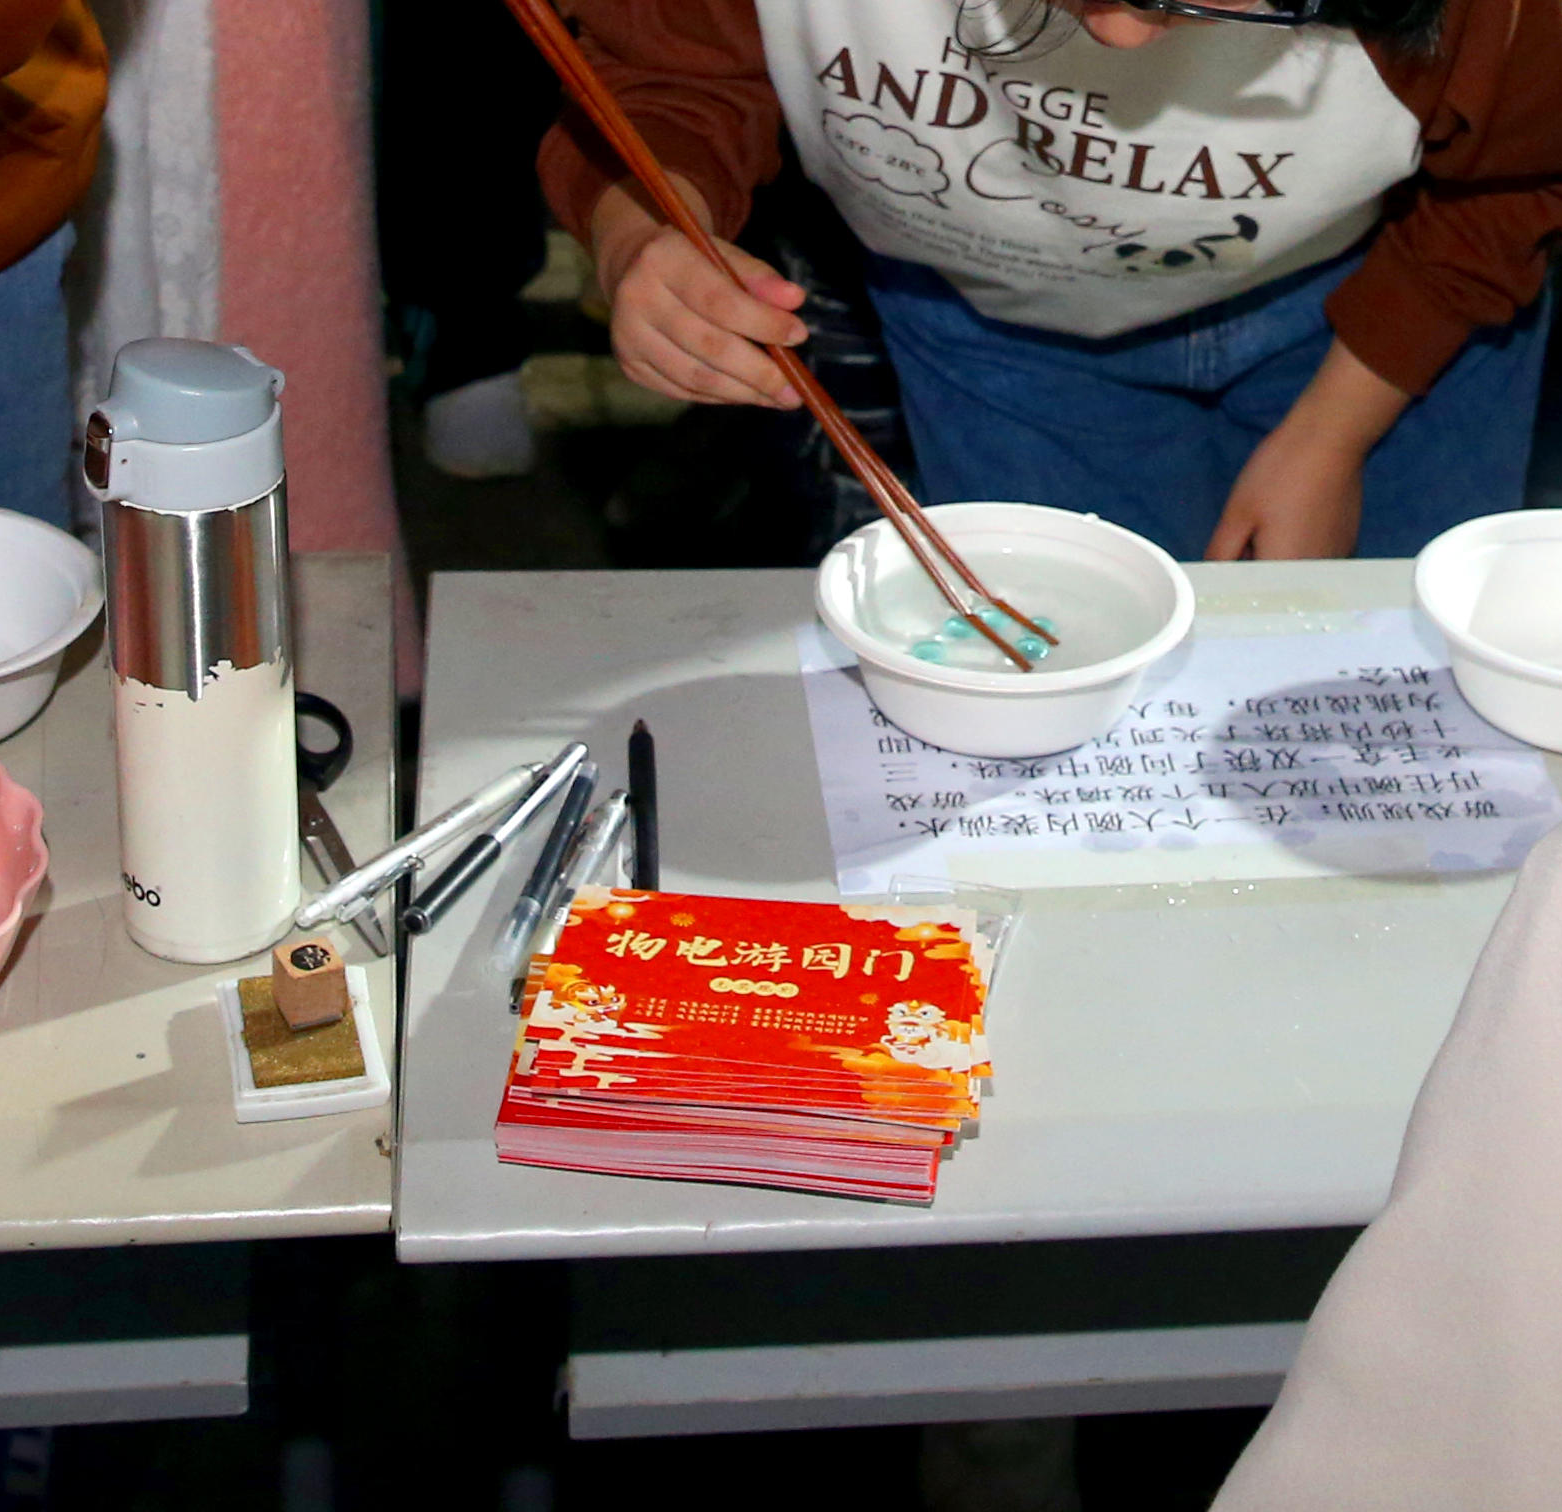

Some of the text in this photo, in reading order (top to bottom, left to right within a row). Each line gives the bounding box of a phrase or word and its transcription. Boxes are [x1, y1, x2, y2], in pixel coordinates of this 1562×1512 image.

[818, 45, 1295, 200] AND RELAX
[605, 929, 916, 983] 物电游园门
